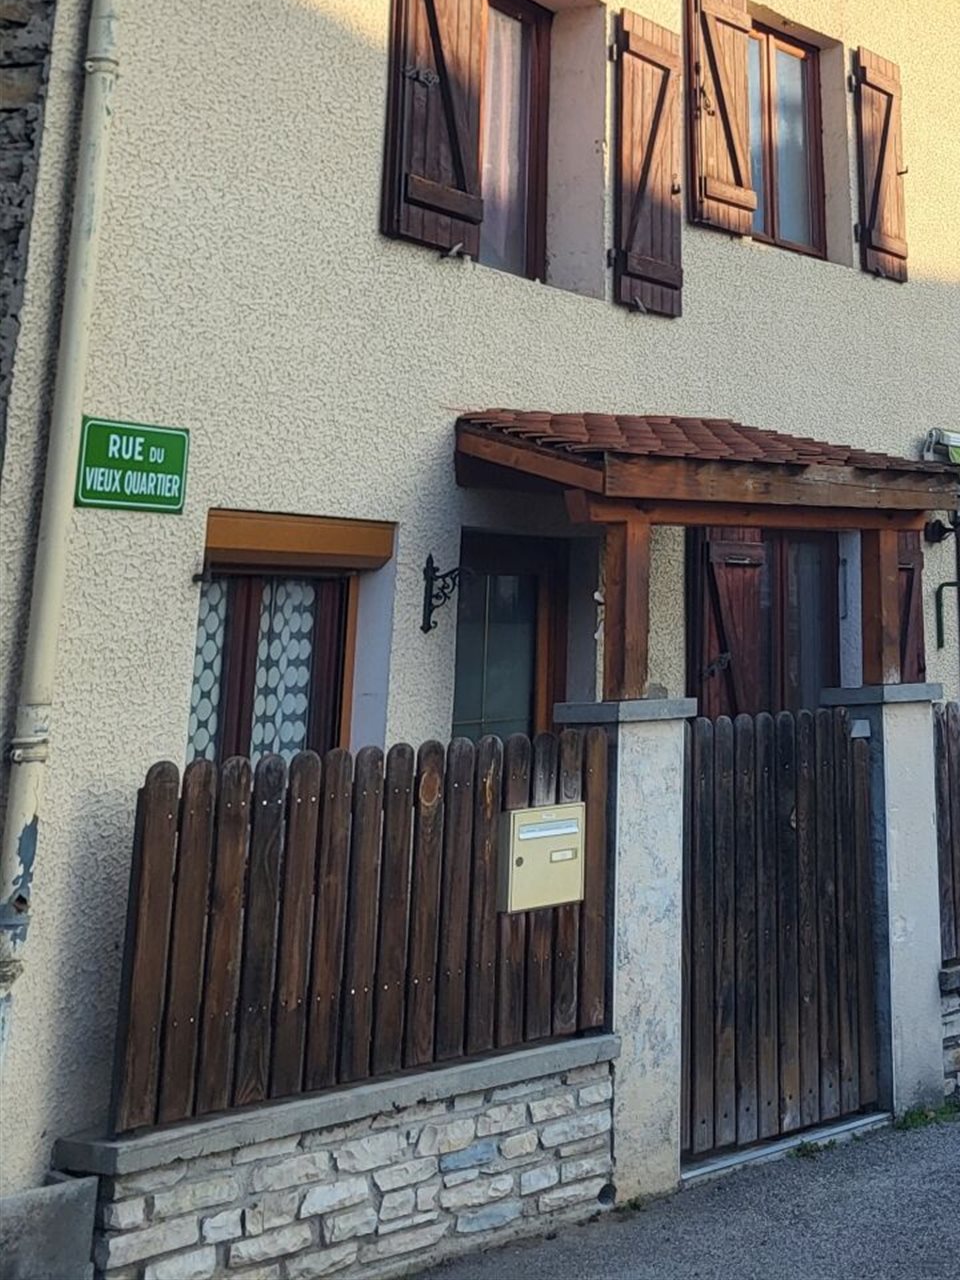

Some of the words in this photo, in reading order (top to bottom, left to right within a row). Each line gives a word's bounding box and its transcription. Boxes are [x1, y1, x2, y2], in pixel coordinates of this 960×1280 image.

[108, 433, 145, 461] RUE
[149, 446, 165, 464] DU
[85, 466, 122, 493] VIEUX
[124, 470, 180, 497] QUARTIER
